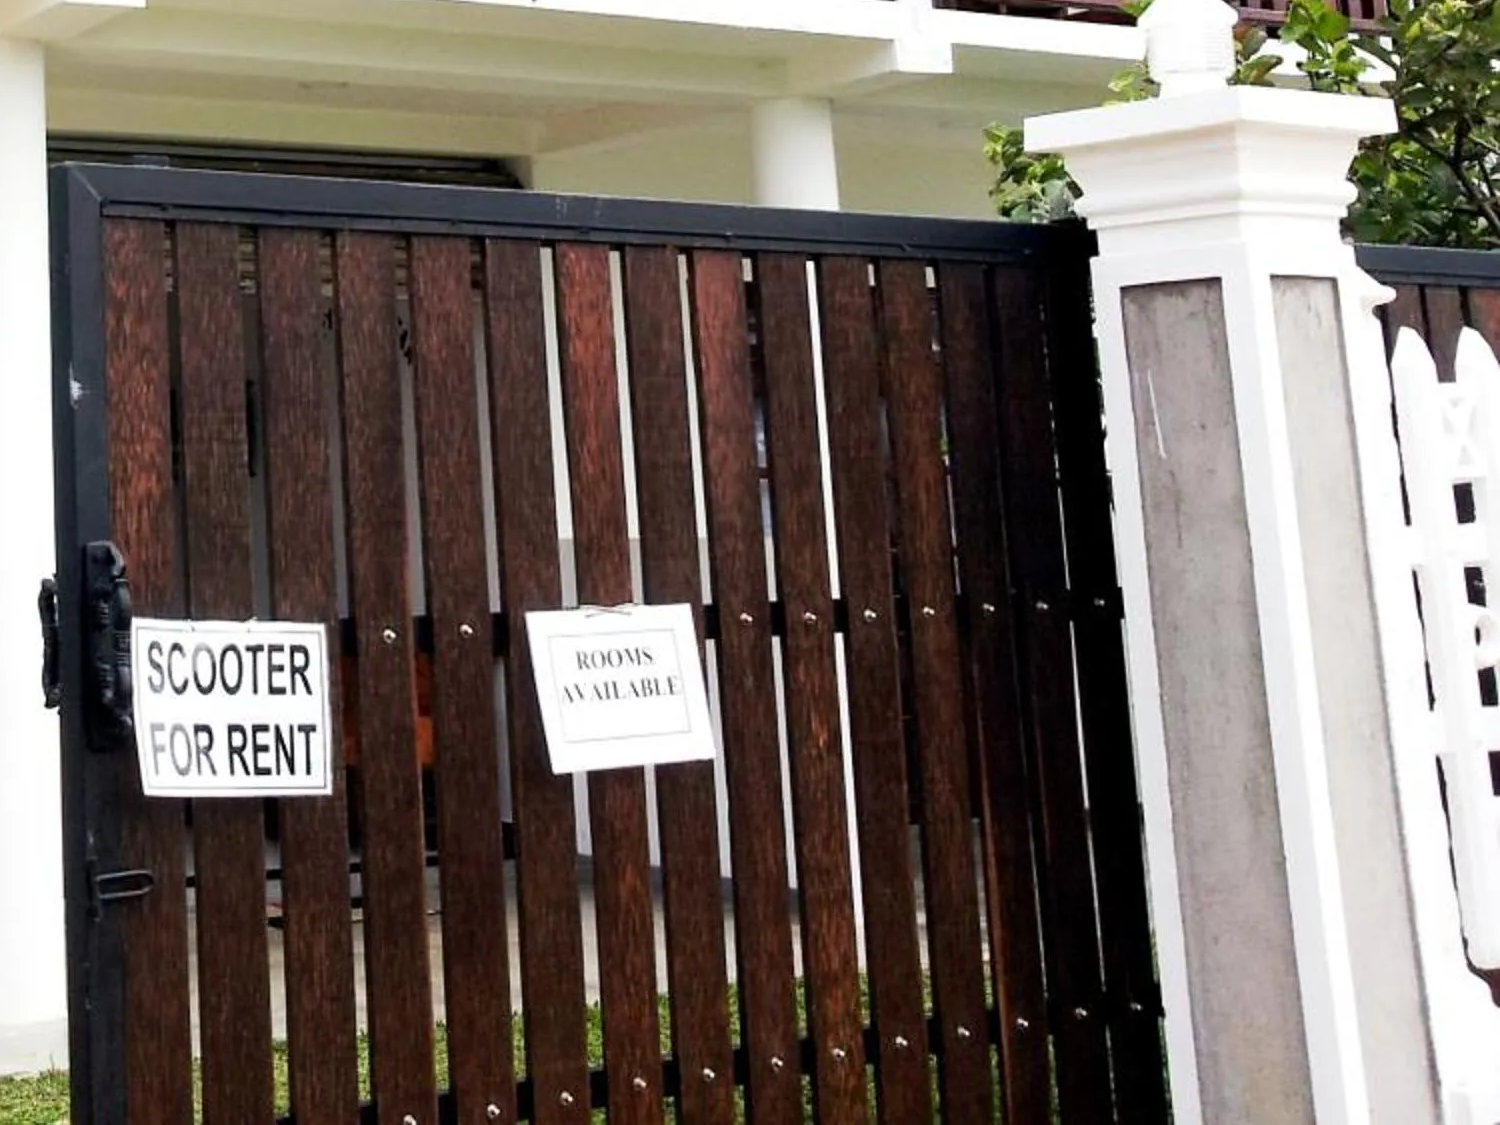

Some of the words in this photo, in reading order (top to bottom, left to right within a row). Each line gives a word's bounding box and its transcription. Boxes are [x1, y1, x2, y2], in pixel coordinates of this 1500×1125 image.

[147, 640, 313, 698] SCOOTER
[575, 648, 655, 672] ROOMS
[561, 675, 683, 706] AVAILABLE
[150, 723, 218, 778] FOR
[227, 723, 317, 778] RENT
